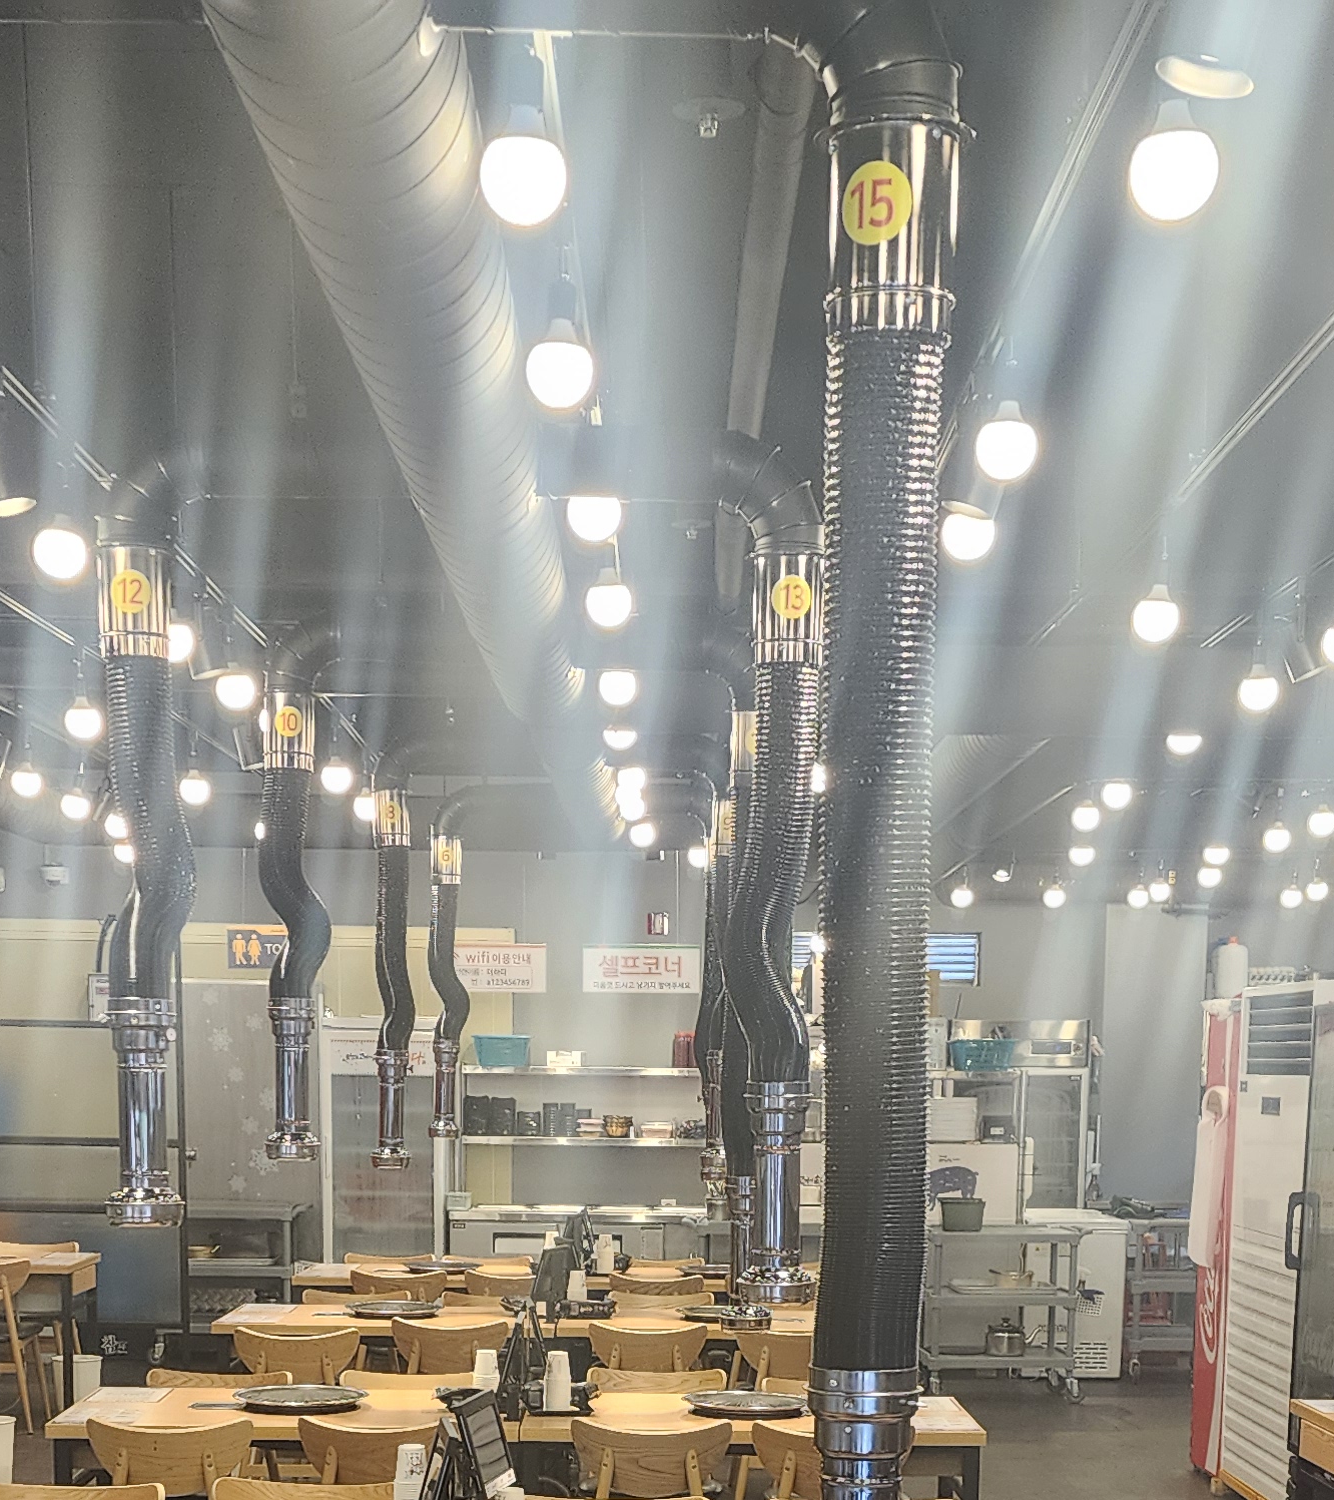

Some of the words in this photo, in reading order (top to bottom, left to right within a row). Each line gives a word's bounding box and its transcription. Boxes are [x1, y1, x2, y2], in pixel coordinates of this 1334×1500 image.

[849, 178, 895, 230] 15
[117, 578, 144, 605] 12
[779, 583, 805, 610] 13
[278, 712, 299, 731] 10
[442, 850, 451, 862] 6
[599, 954, 682, 979] 셀프코너
